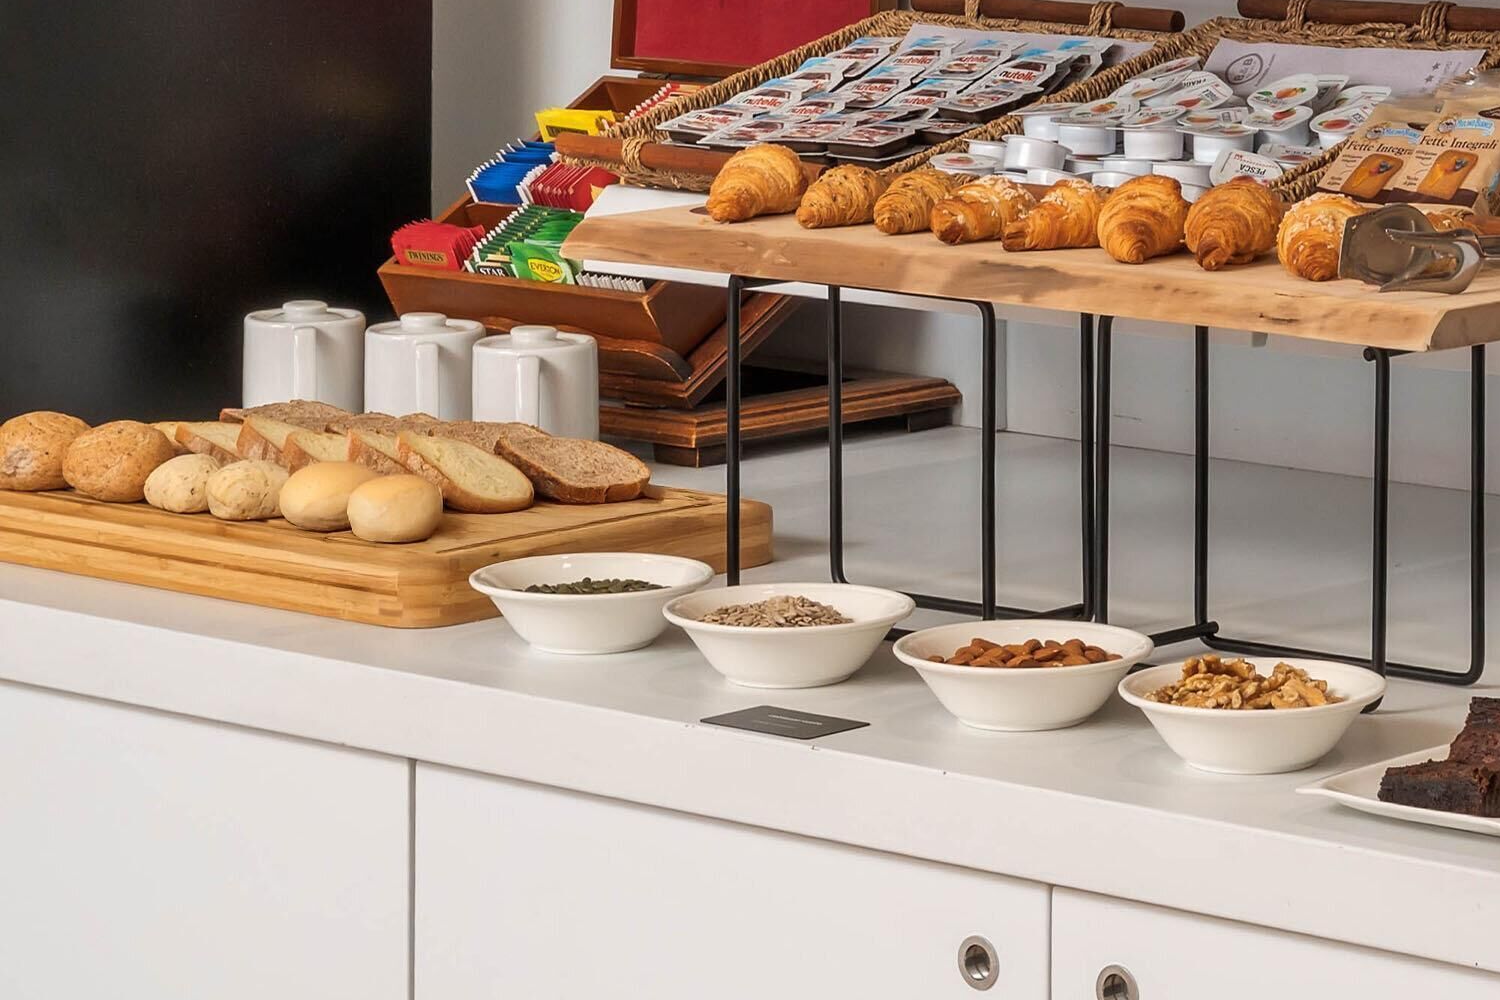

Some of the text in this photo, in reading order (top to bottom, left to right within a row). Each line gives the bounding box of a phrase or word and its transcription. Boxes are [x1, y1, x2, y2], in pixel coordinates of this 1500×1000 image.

[999, 70, 1037, 81] nutella
[743, 96, 782, 107] nutella
[1419, 135, 1500, 150] Fette Integrali
[1349, 142, 1375, 152] Fette
[1375, 145, 1413, 156] Integra
[1239, 163, 1267, 176] PESCA
[408, 251, 444, 262] TWININGS
[480, 267, 506, 277] STAR
